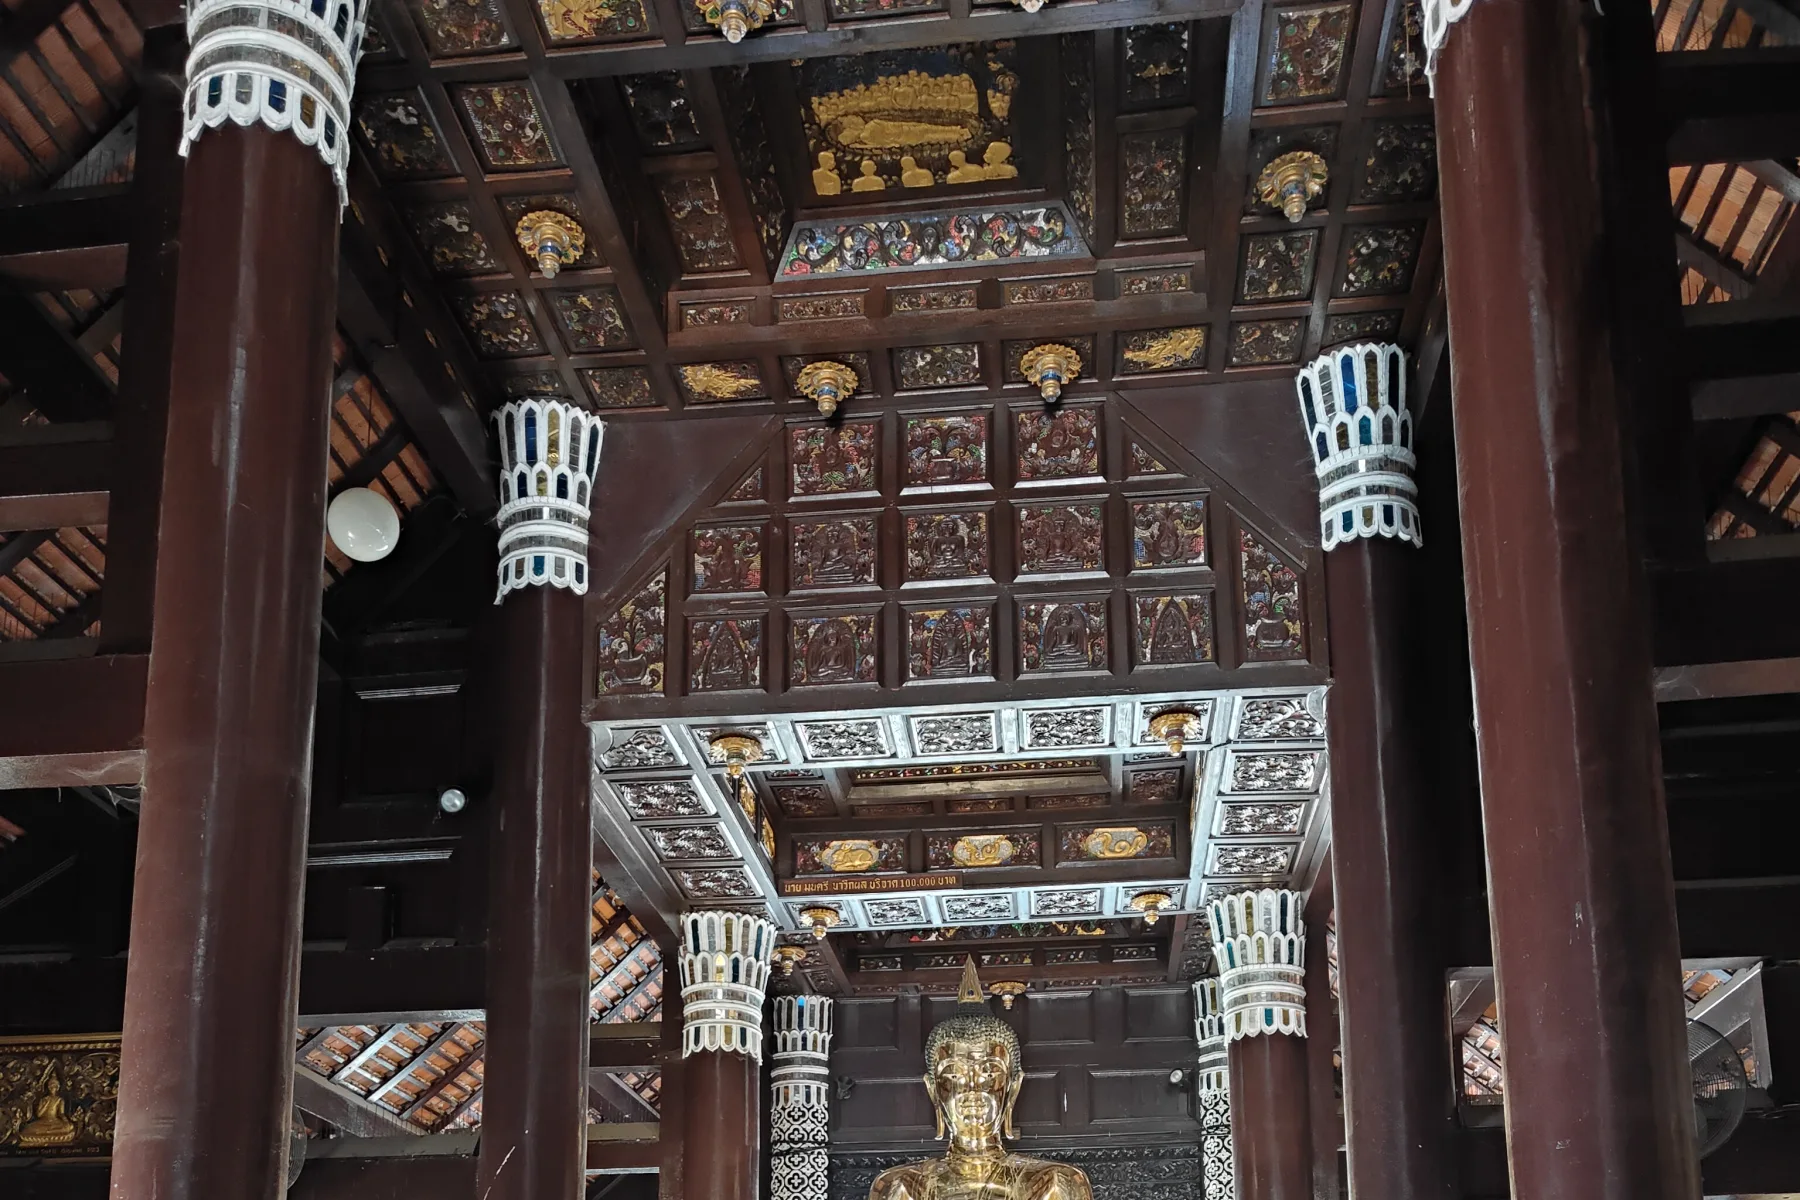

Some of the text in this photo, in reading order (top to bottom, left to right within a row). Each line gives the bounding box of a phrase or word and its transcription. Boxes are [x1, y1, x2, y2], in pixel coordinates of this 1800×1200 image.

[784, 883, 802, 893] นาย
[804, 881, 829, 892] มนตรี
[869, 878, 898, 889] บริจาค
[937, 876, 956, 885] บาท
